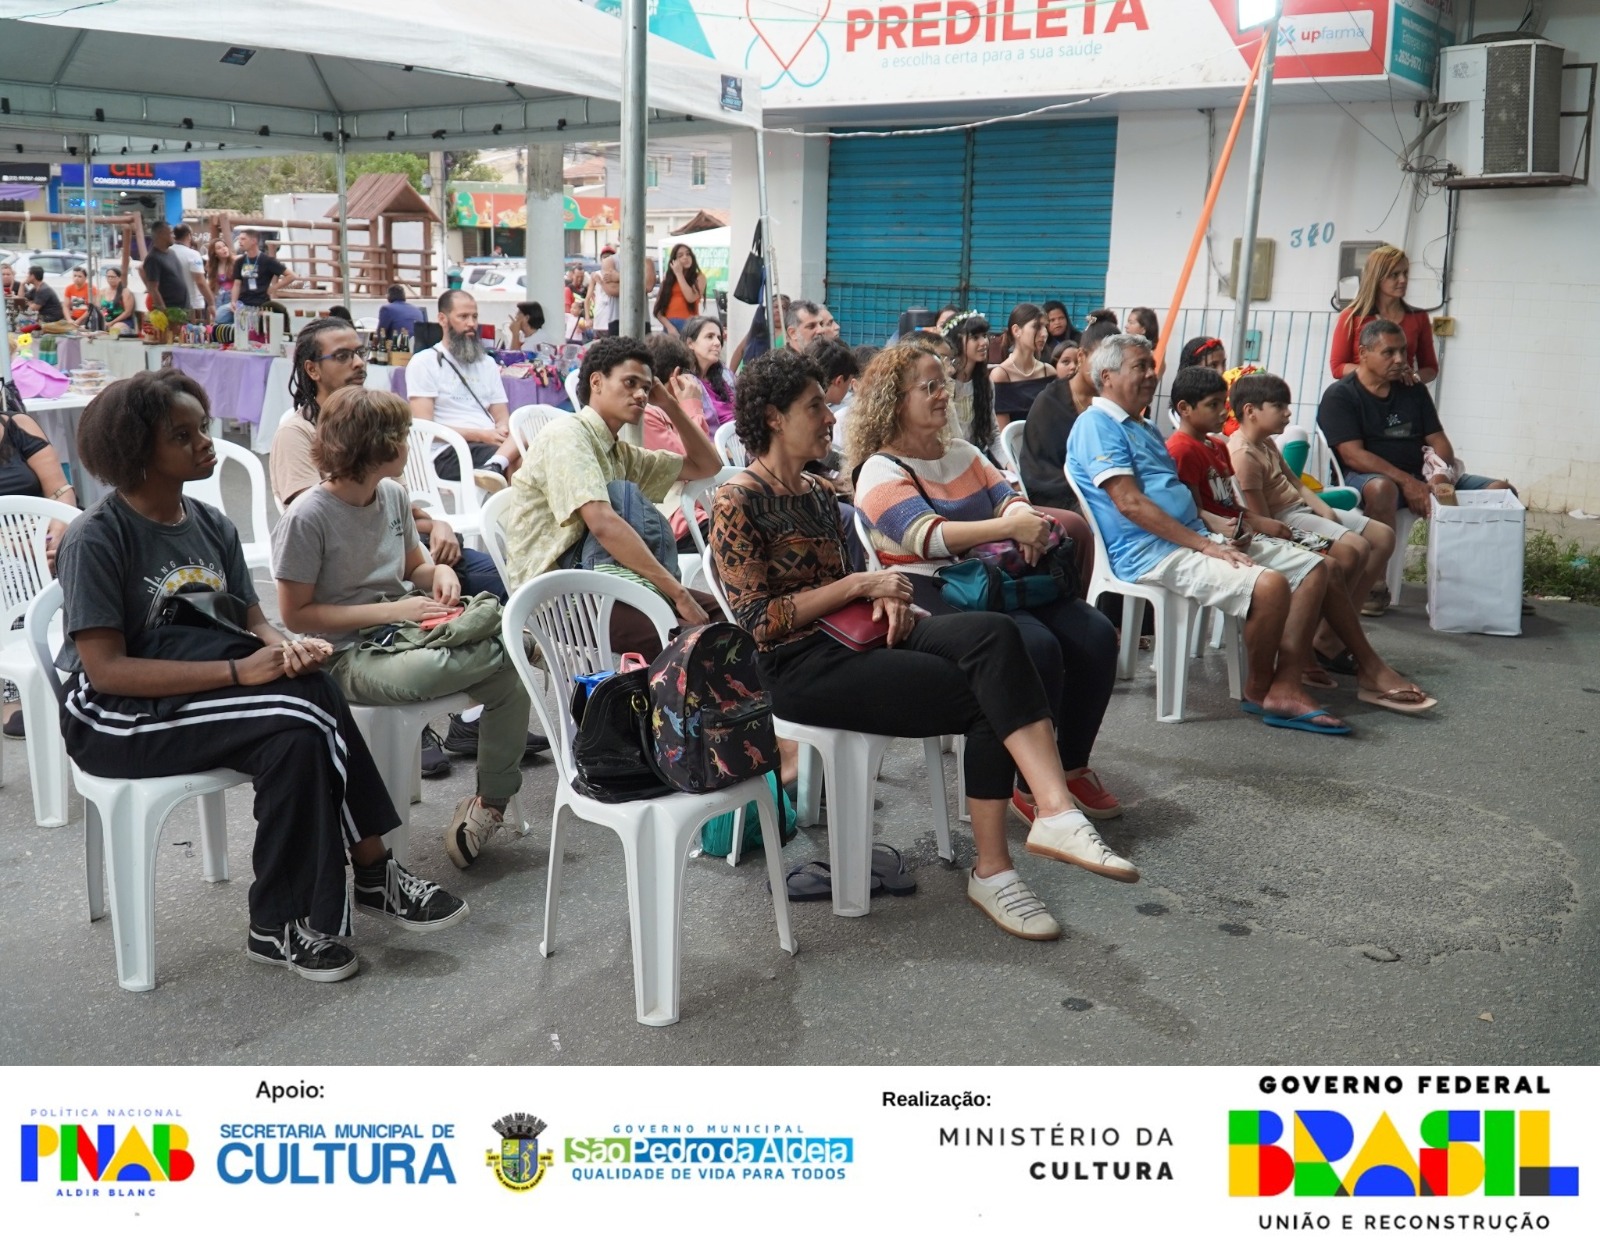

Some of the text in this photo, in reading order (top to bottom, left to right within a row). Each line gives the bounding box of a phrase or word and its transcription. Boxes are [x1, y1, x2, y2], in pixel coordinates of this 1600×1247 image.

[1301, 26, 1365, 43] upfarma
[881, 40, 1103, 68] a escolha certa para a sua saúde
[110, 163, 154, 178] CELL
[93, 177, 130, 186] CONSERTOS
[137, 178, 176, 187] ACESSÓRIOS
[147, 560, 177, 595] HANG
